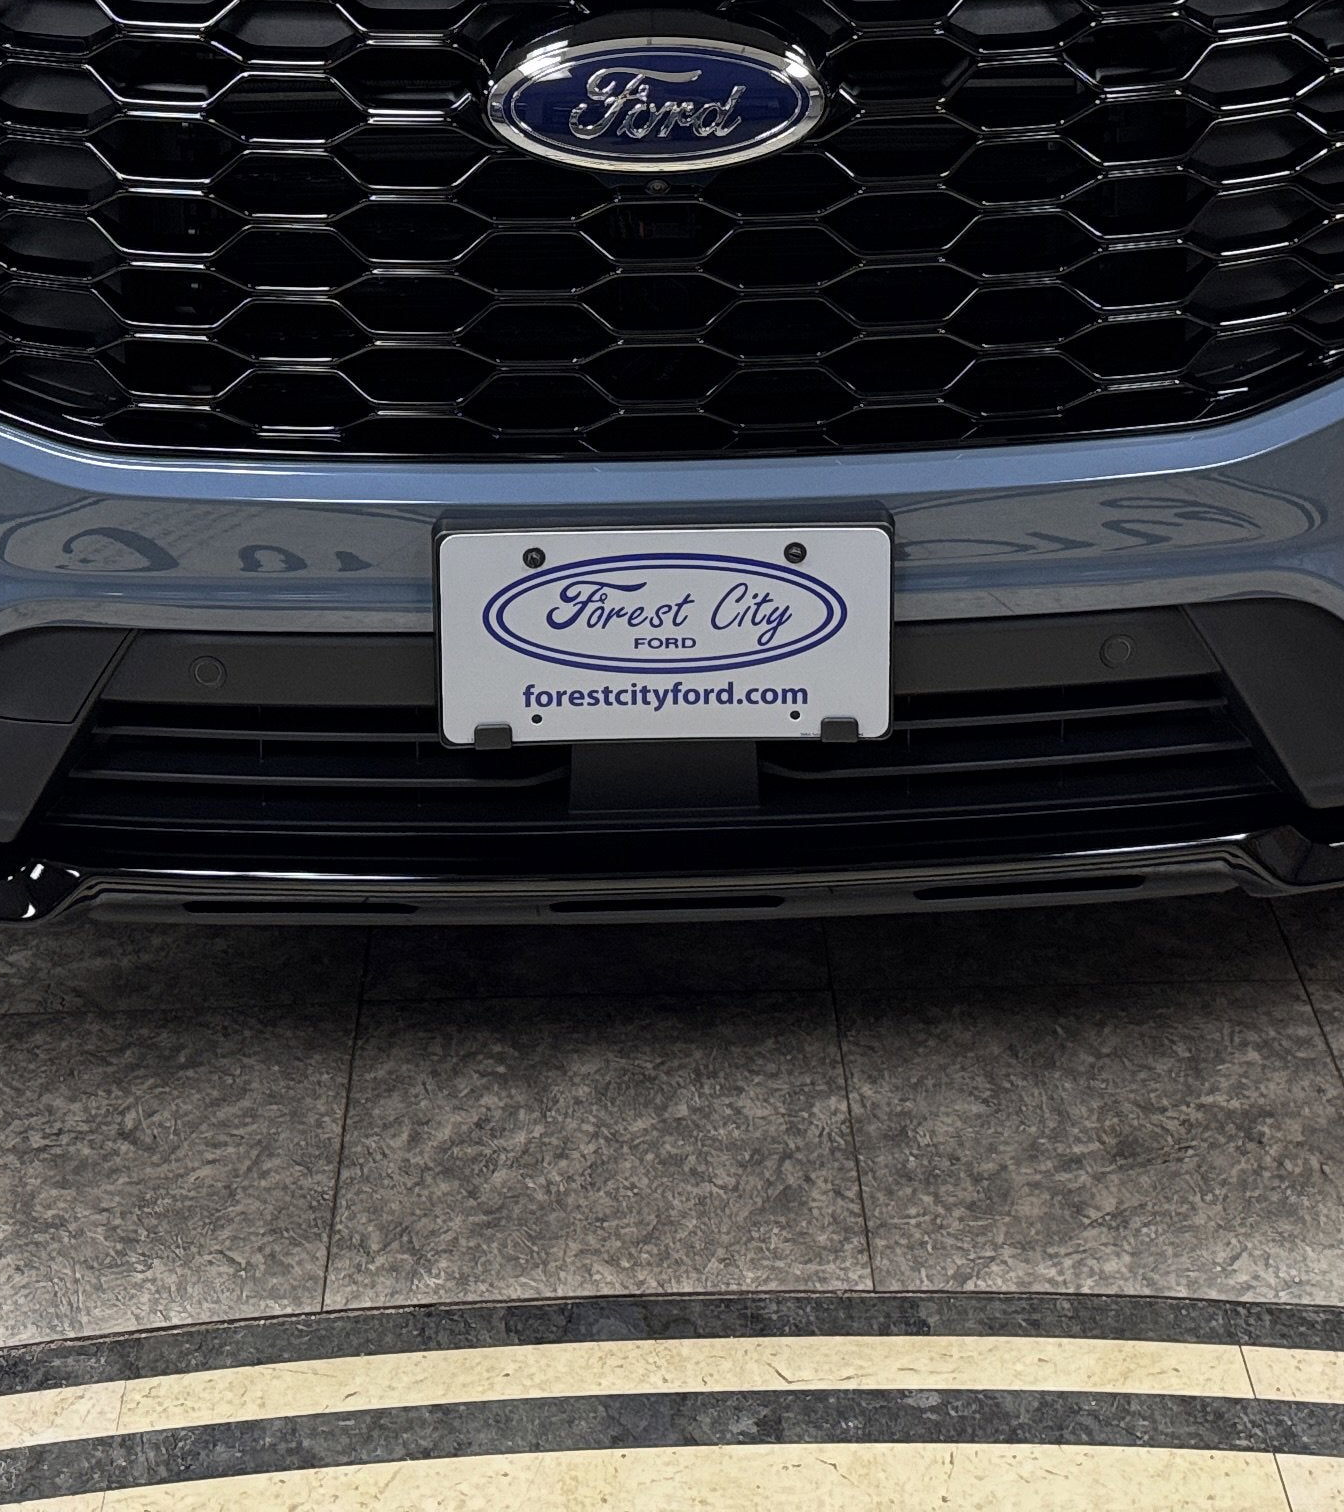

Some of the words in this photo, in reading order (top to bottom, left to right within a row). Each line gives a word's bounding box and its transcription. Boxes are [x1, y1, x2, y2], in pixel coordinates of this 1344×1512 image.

[568, 67, 747, 140] Ford
[545, 580, 697, 631] Forest
[709, 582, 794, 647] City
[633, 637, 698, 650] FORD
[522, 681, 809, 712] forestcityford.com
